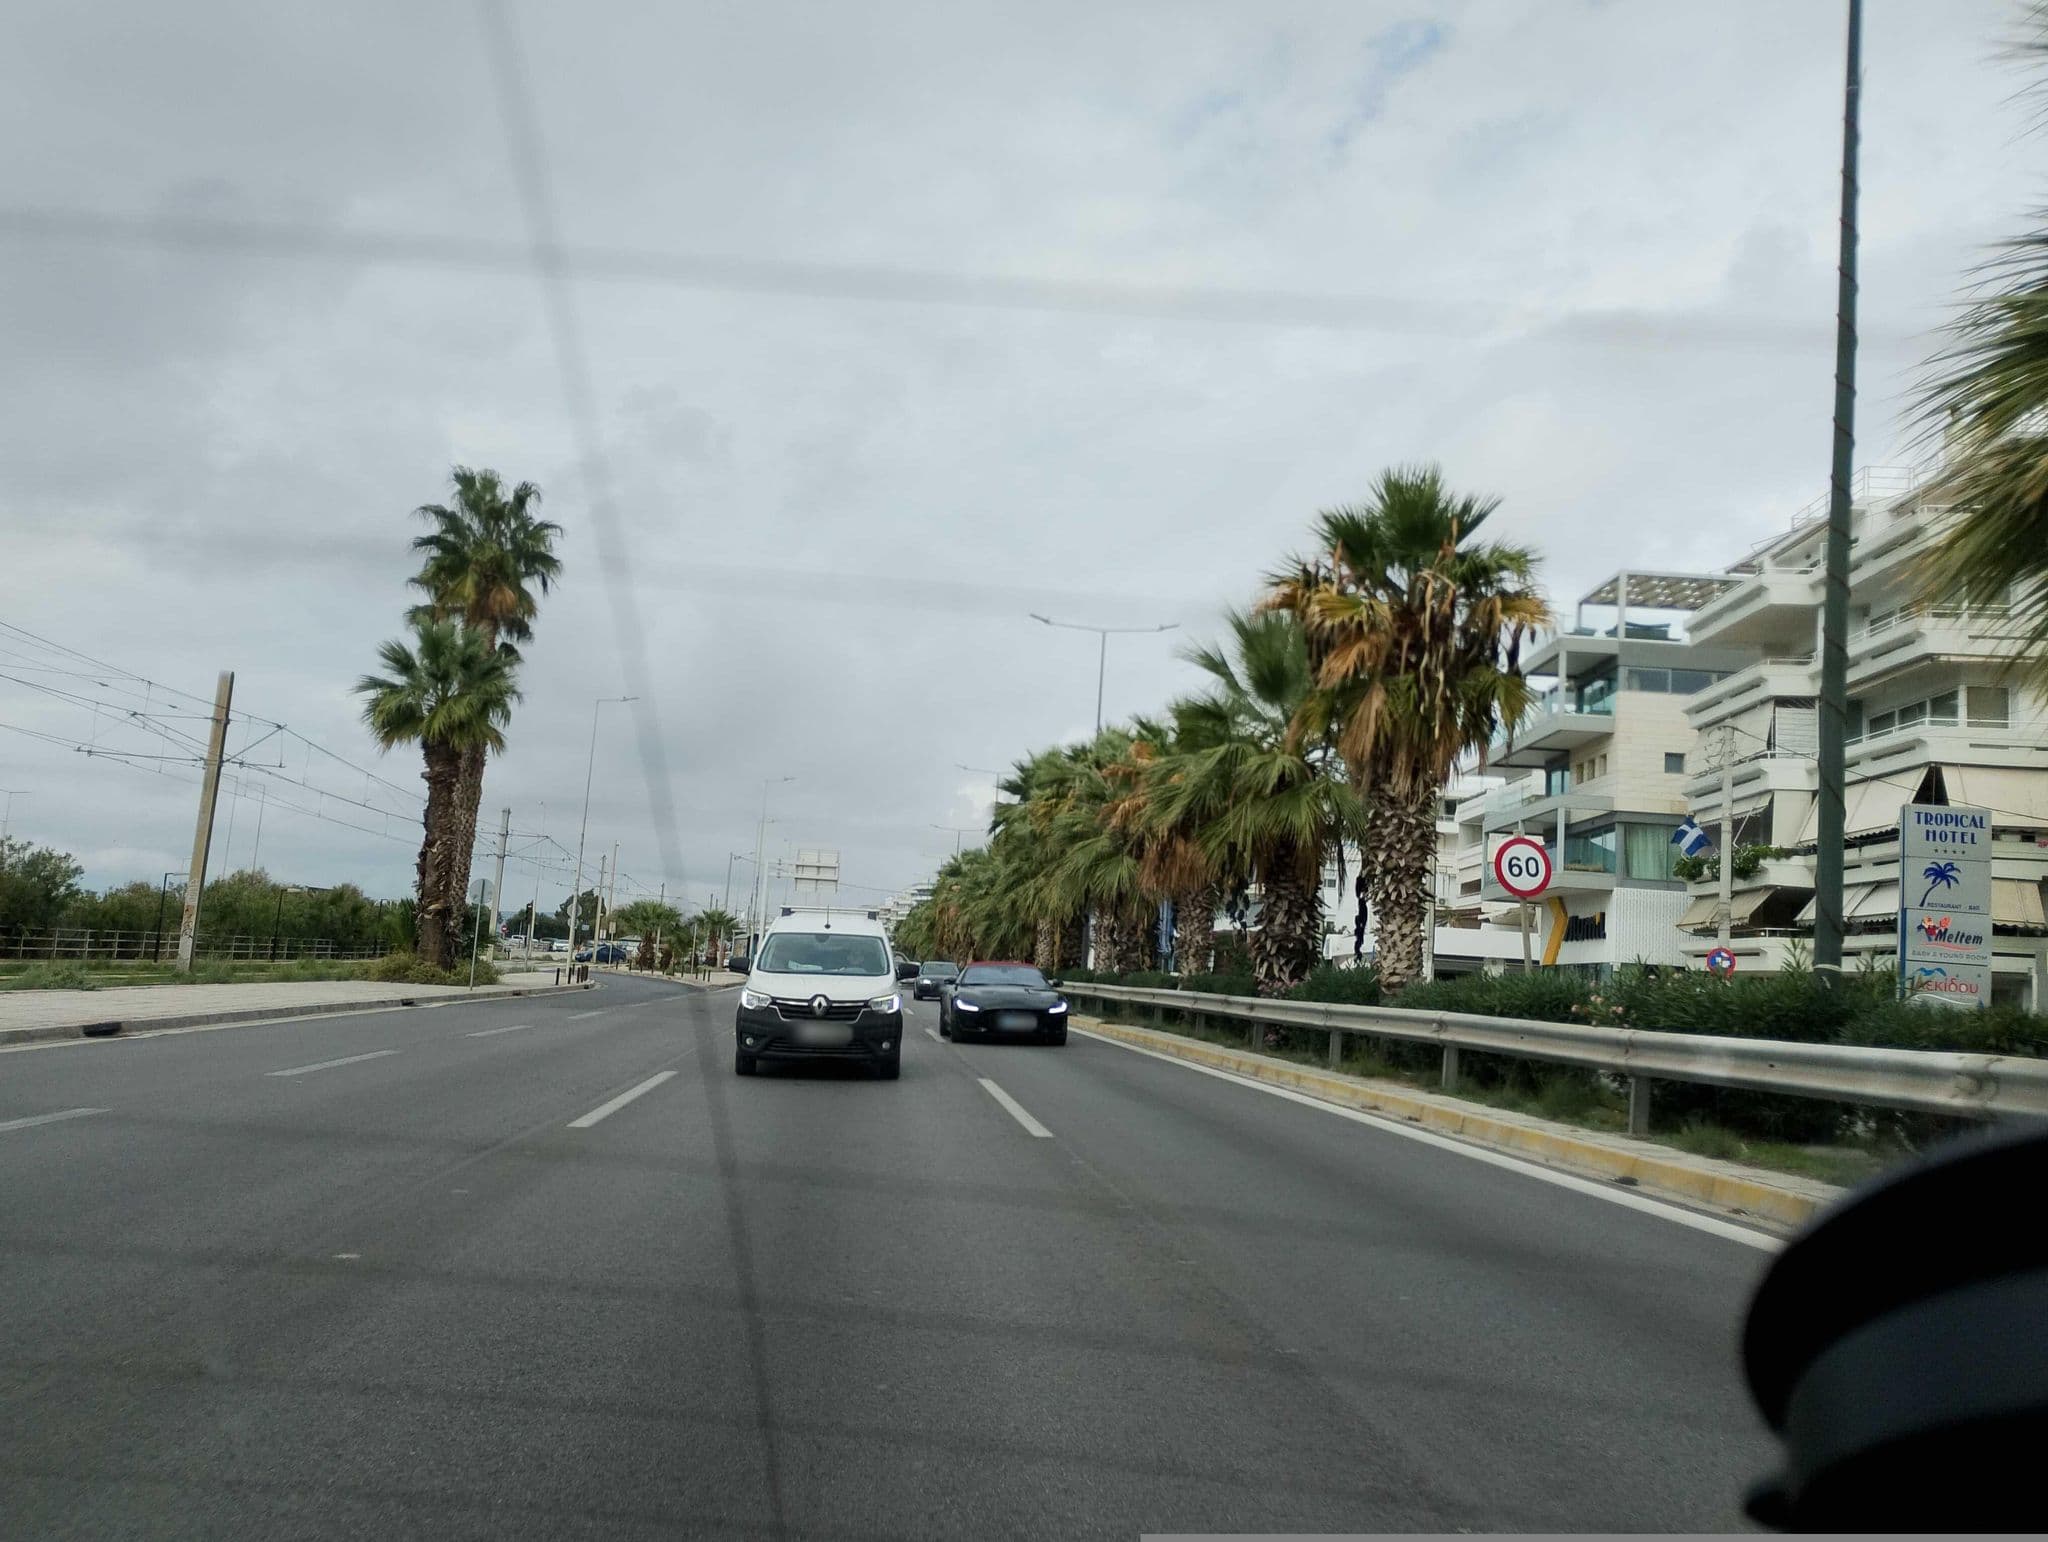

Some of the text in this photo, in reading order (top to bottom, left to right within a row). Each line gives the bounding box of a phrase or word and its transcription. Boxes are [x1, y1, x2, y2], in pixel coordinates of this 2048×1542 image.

[1914, 811, 1986, 829] TROPICAL
[1925, 829, 1977, 845] HOTEL
[1507, 856, 1540, 878] 60
[1934, 928, 1984, 945] Meltem
